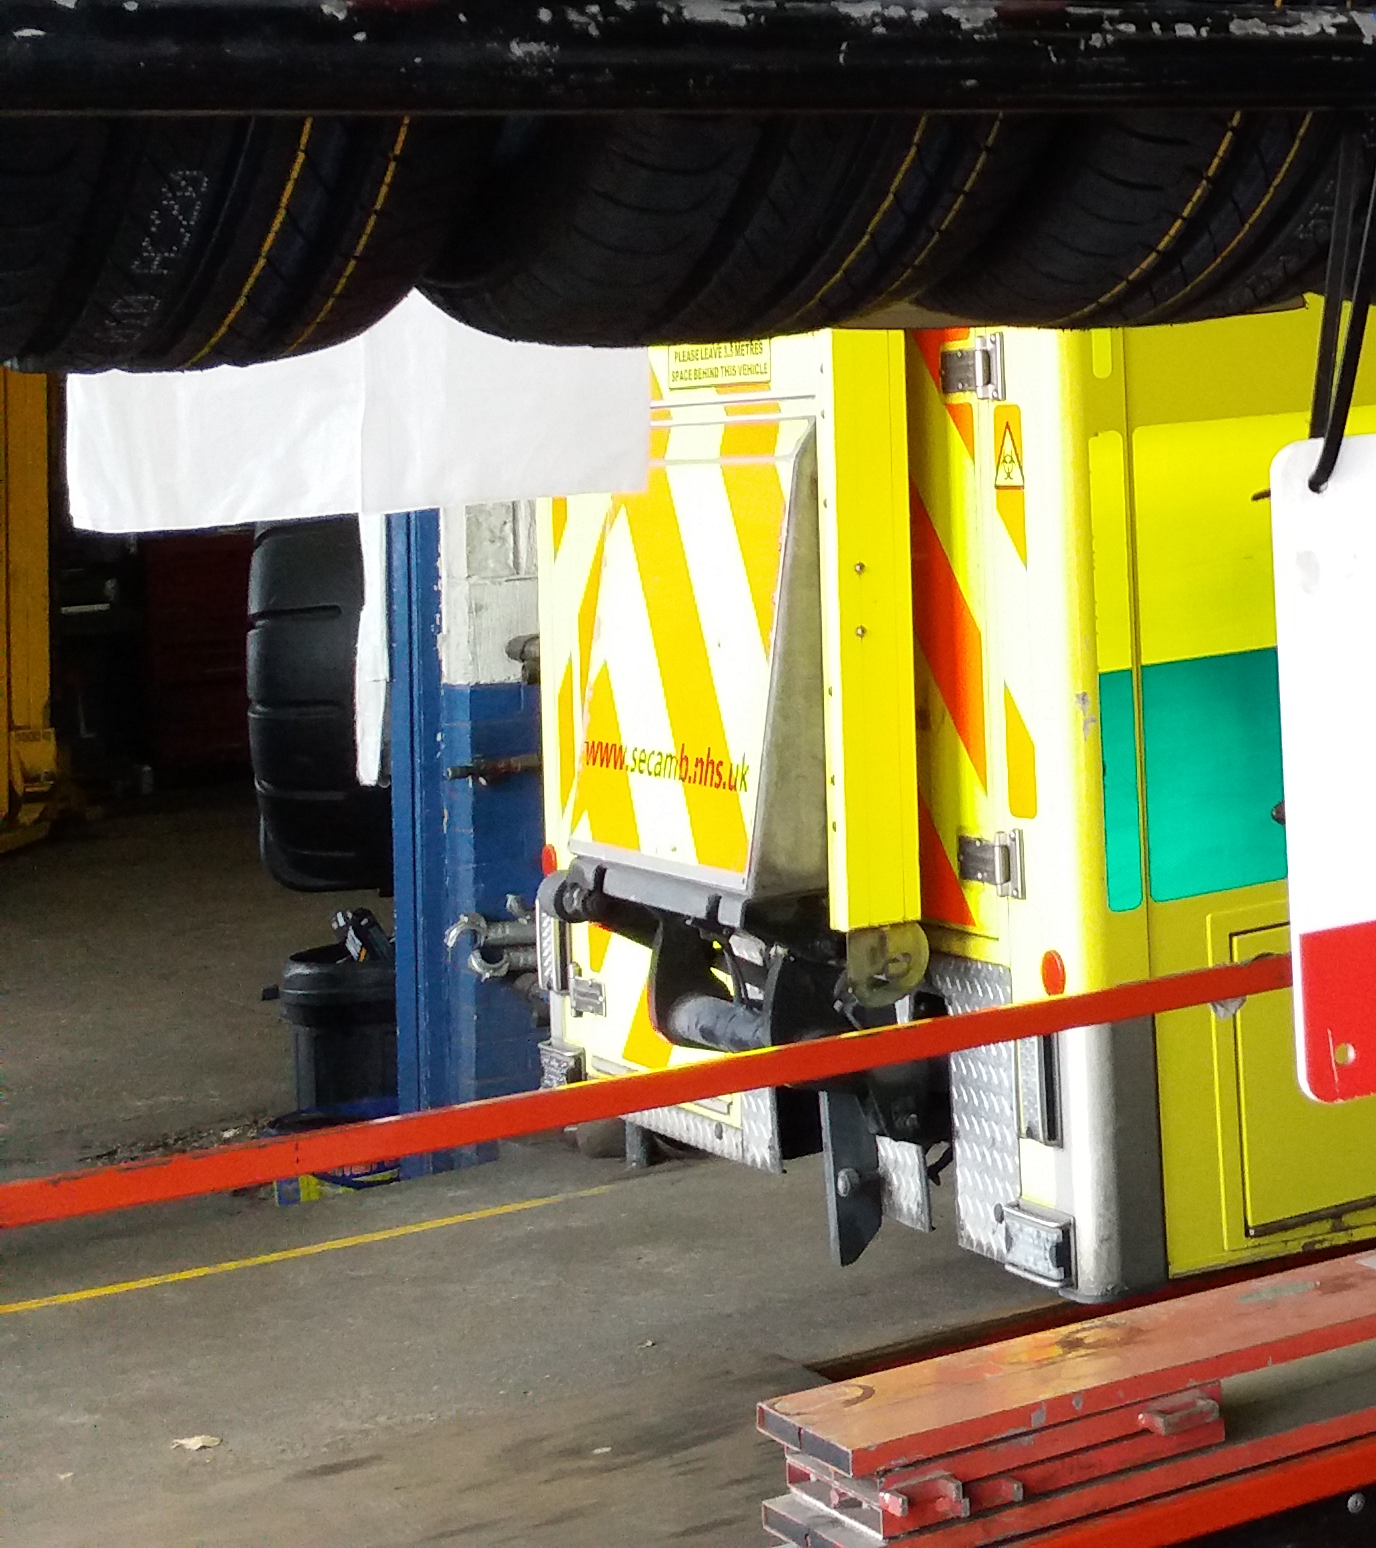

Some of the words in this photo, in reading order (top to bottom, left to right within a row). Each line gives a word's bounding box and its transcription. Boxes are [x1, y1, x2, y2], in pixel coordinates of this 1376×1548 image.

[674, 348, 700, 363] PLEASE
[700, 344, 723, 361] LEAVE
[734, 341, 763, 357] METRES
[671, 368, 693, 382] SPACE
[693, 366, 719, 381] BEHIND
[720, 365, 737, 378] THIS
[737, 362, 768, 376] VEHICLE
[584, 737, 751, 794] www.secamb.nhs.uk
